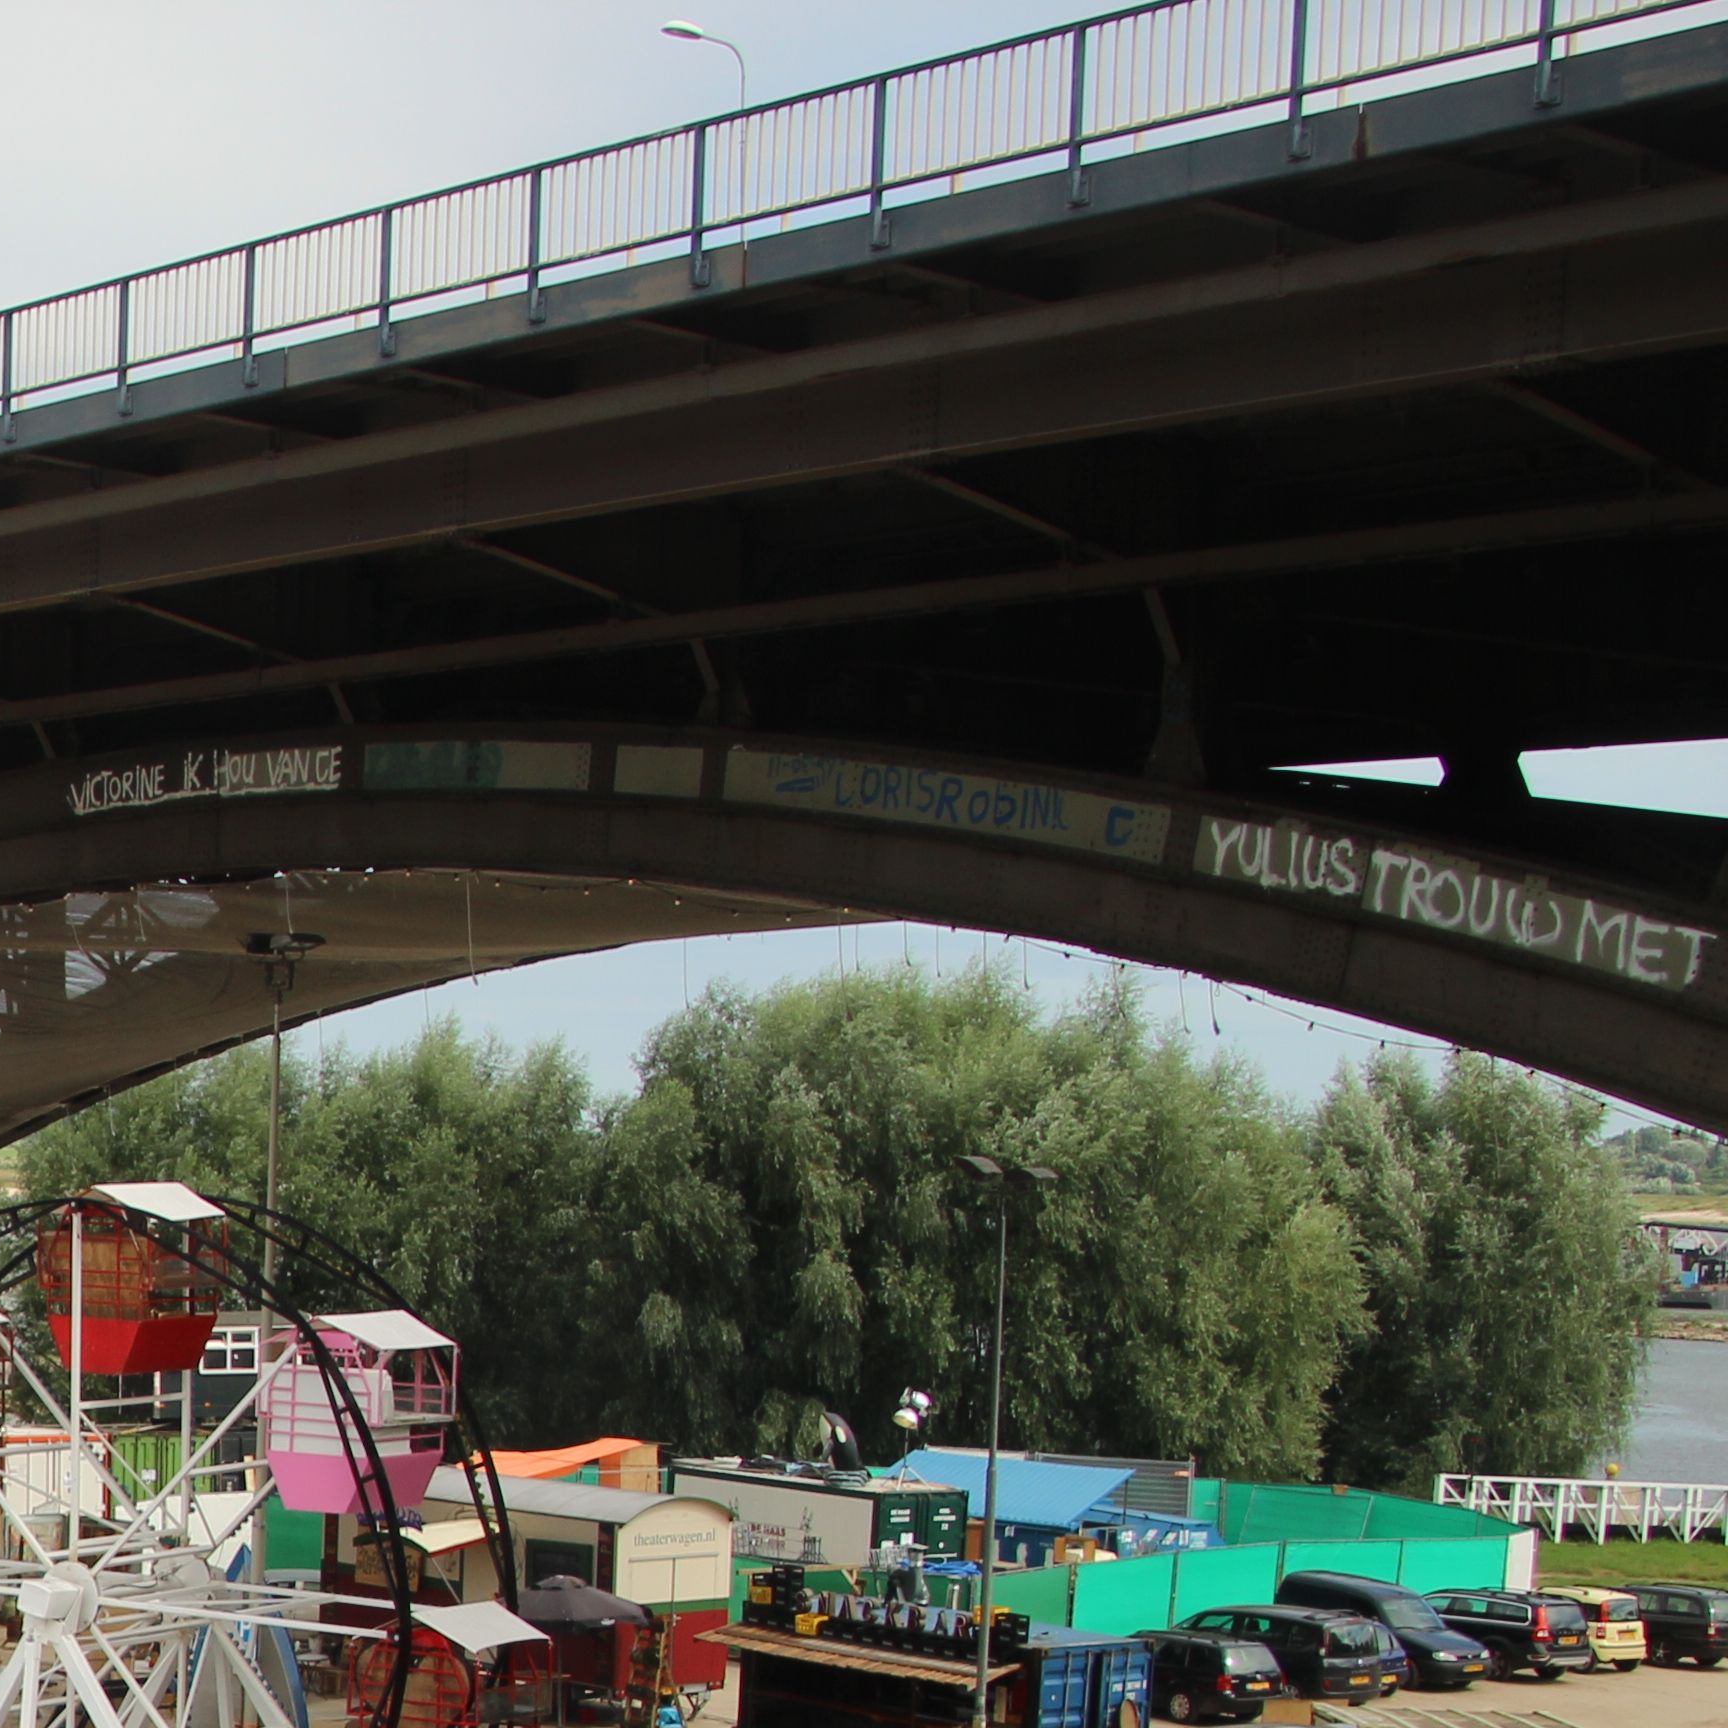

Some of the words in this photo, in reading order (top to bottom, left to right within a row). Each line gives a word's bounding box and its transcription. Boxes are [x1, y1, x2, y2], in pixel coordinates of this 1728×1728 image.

[1210, 820, 1361, 896] YULIUS
[1370, 849, 1562, 947] TROUW
[1575, 899, 1718, 985] MET
[634, 1528, 716, 1547] theaterwagen.nl
[794, 1587, 976, 1638] SNACKBAR
